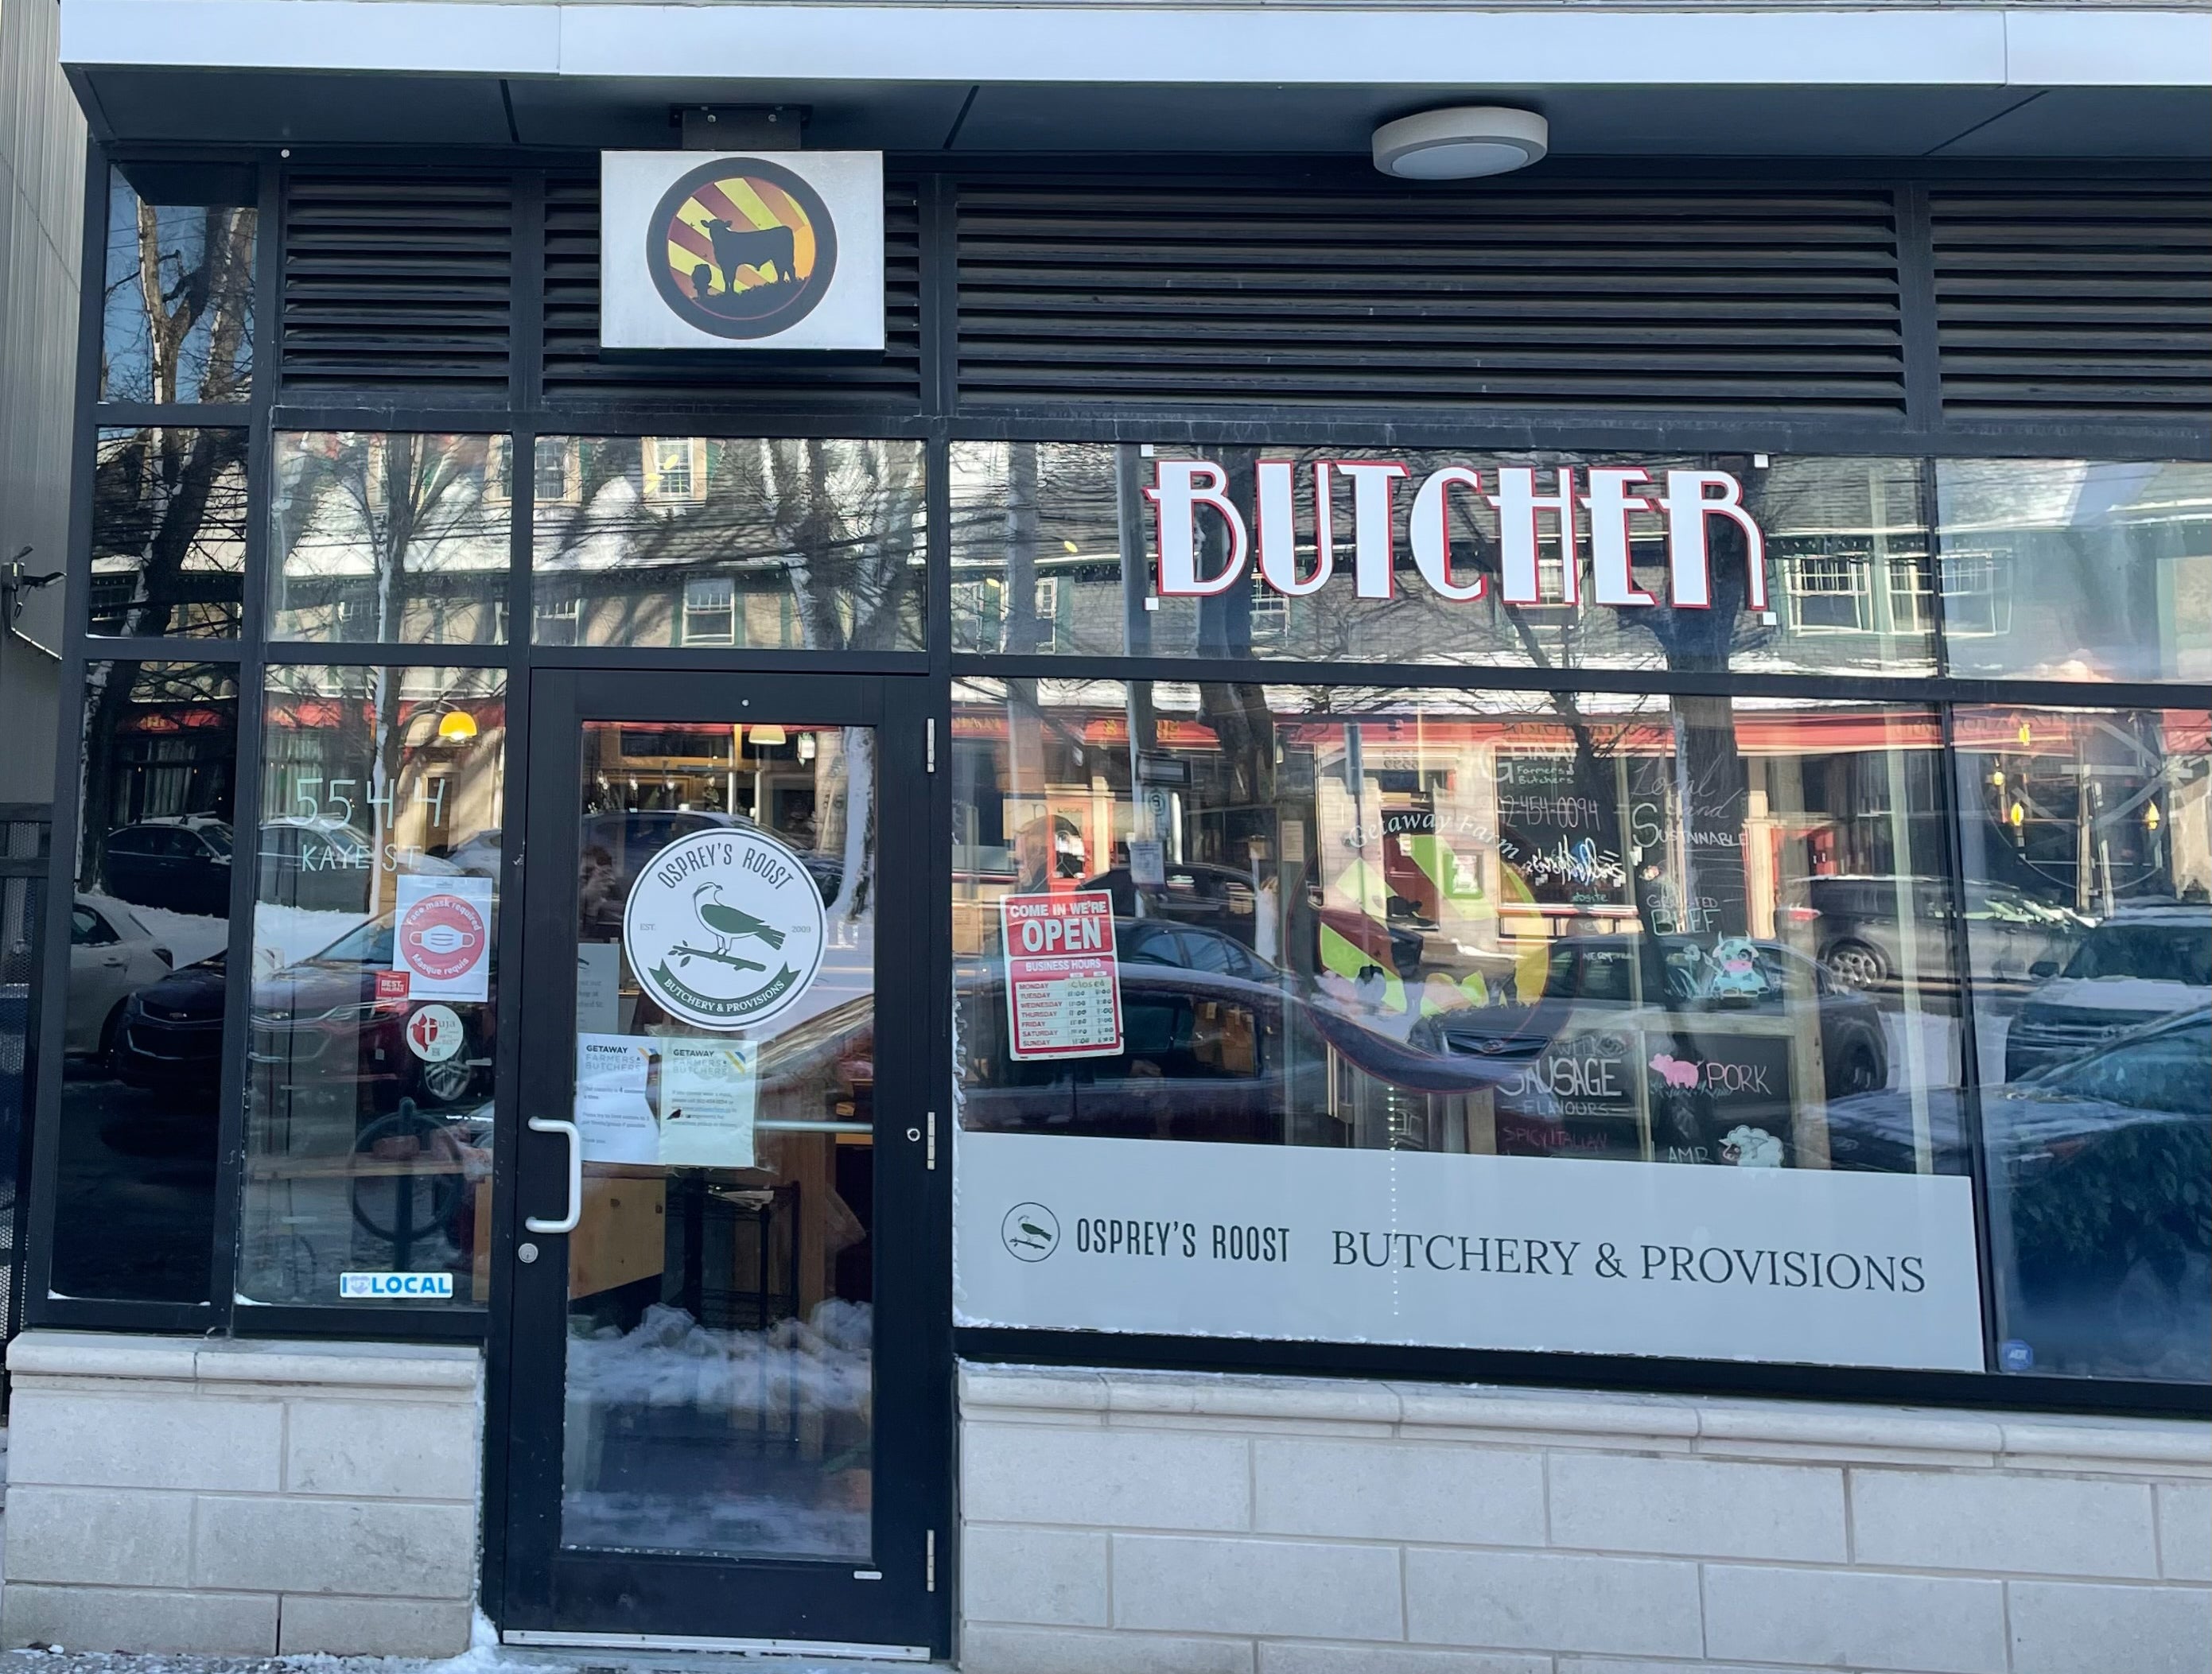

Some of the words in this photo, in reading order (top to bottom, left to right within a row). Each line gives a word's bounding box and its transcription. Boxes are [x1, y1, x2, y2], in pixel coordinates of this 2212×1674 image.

[1142, 459, 1768, 611] BUTCHER
[1517, 765, 1566, 775] Farmers
[1518, 775, 1574, 784] Butchers
[286, 777, 445, 830] 5544
[1349, 812, 1451, 849] Getaway
[1459, 814, 1521, 860] Farm
[302, 844, 370, 872] KAYE
[658, 843, 733, 889] OSPREY'S
[742, 848, 794, 890] ROOST
[406, 906, 425, 926] Face
[425, 899, 450, 911] mask
[451, 900, 483, 931] required
[1009, 904, 1049, 918] COME
[1052, 903, 1067, 915] IN
[1070, 900, 1108, 915] WE'RE
[639, 922, 656, 931] EST.
[1022, 917, 1102, 952] OPEN
[412, 954, 442, 976] Masque
[443, 957, 469, 975] requis
[1025, 959, 1069, 972] BUSINESS
[1071, 957, 1102, 970] HOURS
[663, 978, 716, 1012] BUTCHERY
[716, 1003, 725, 1012] &
[726, 980, 785, 1012] PROVISIONS
[585, 1054, 636, 1063] FARMERS
[586, 1045, 628, 1054] GETAWAY
[585, 1062, 641, 1071] BUTCHERS
[1496, 1056, 1622, 1097] SAUSAGE
[1705, 1062, 1771, 1095] PORK
[1523, 1099, 1609, 1116] FLAVOURS
[1503, 1127, 1547, 1148] SPICY
[1076, 1218, 1195, 1258] OSPREY'S
[1212, 1224, 1290, 1263] ROOST
[1331, 1229, 1581, 1276] BUTCHERY
[1595, 1242, 1627, 1279] &
[1640, 1245, 1926, 1293] PROVISIONS
[342, 1276, 348, 1294] I
[371, 1276, 451, 1294] LOCAL
